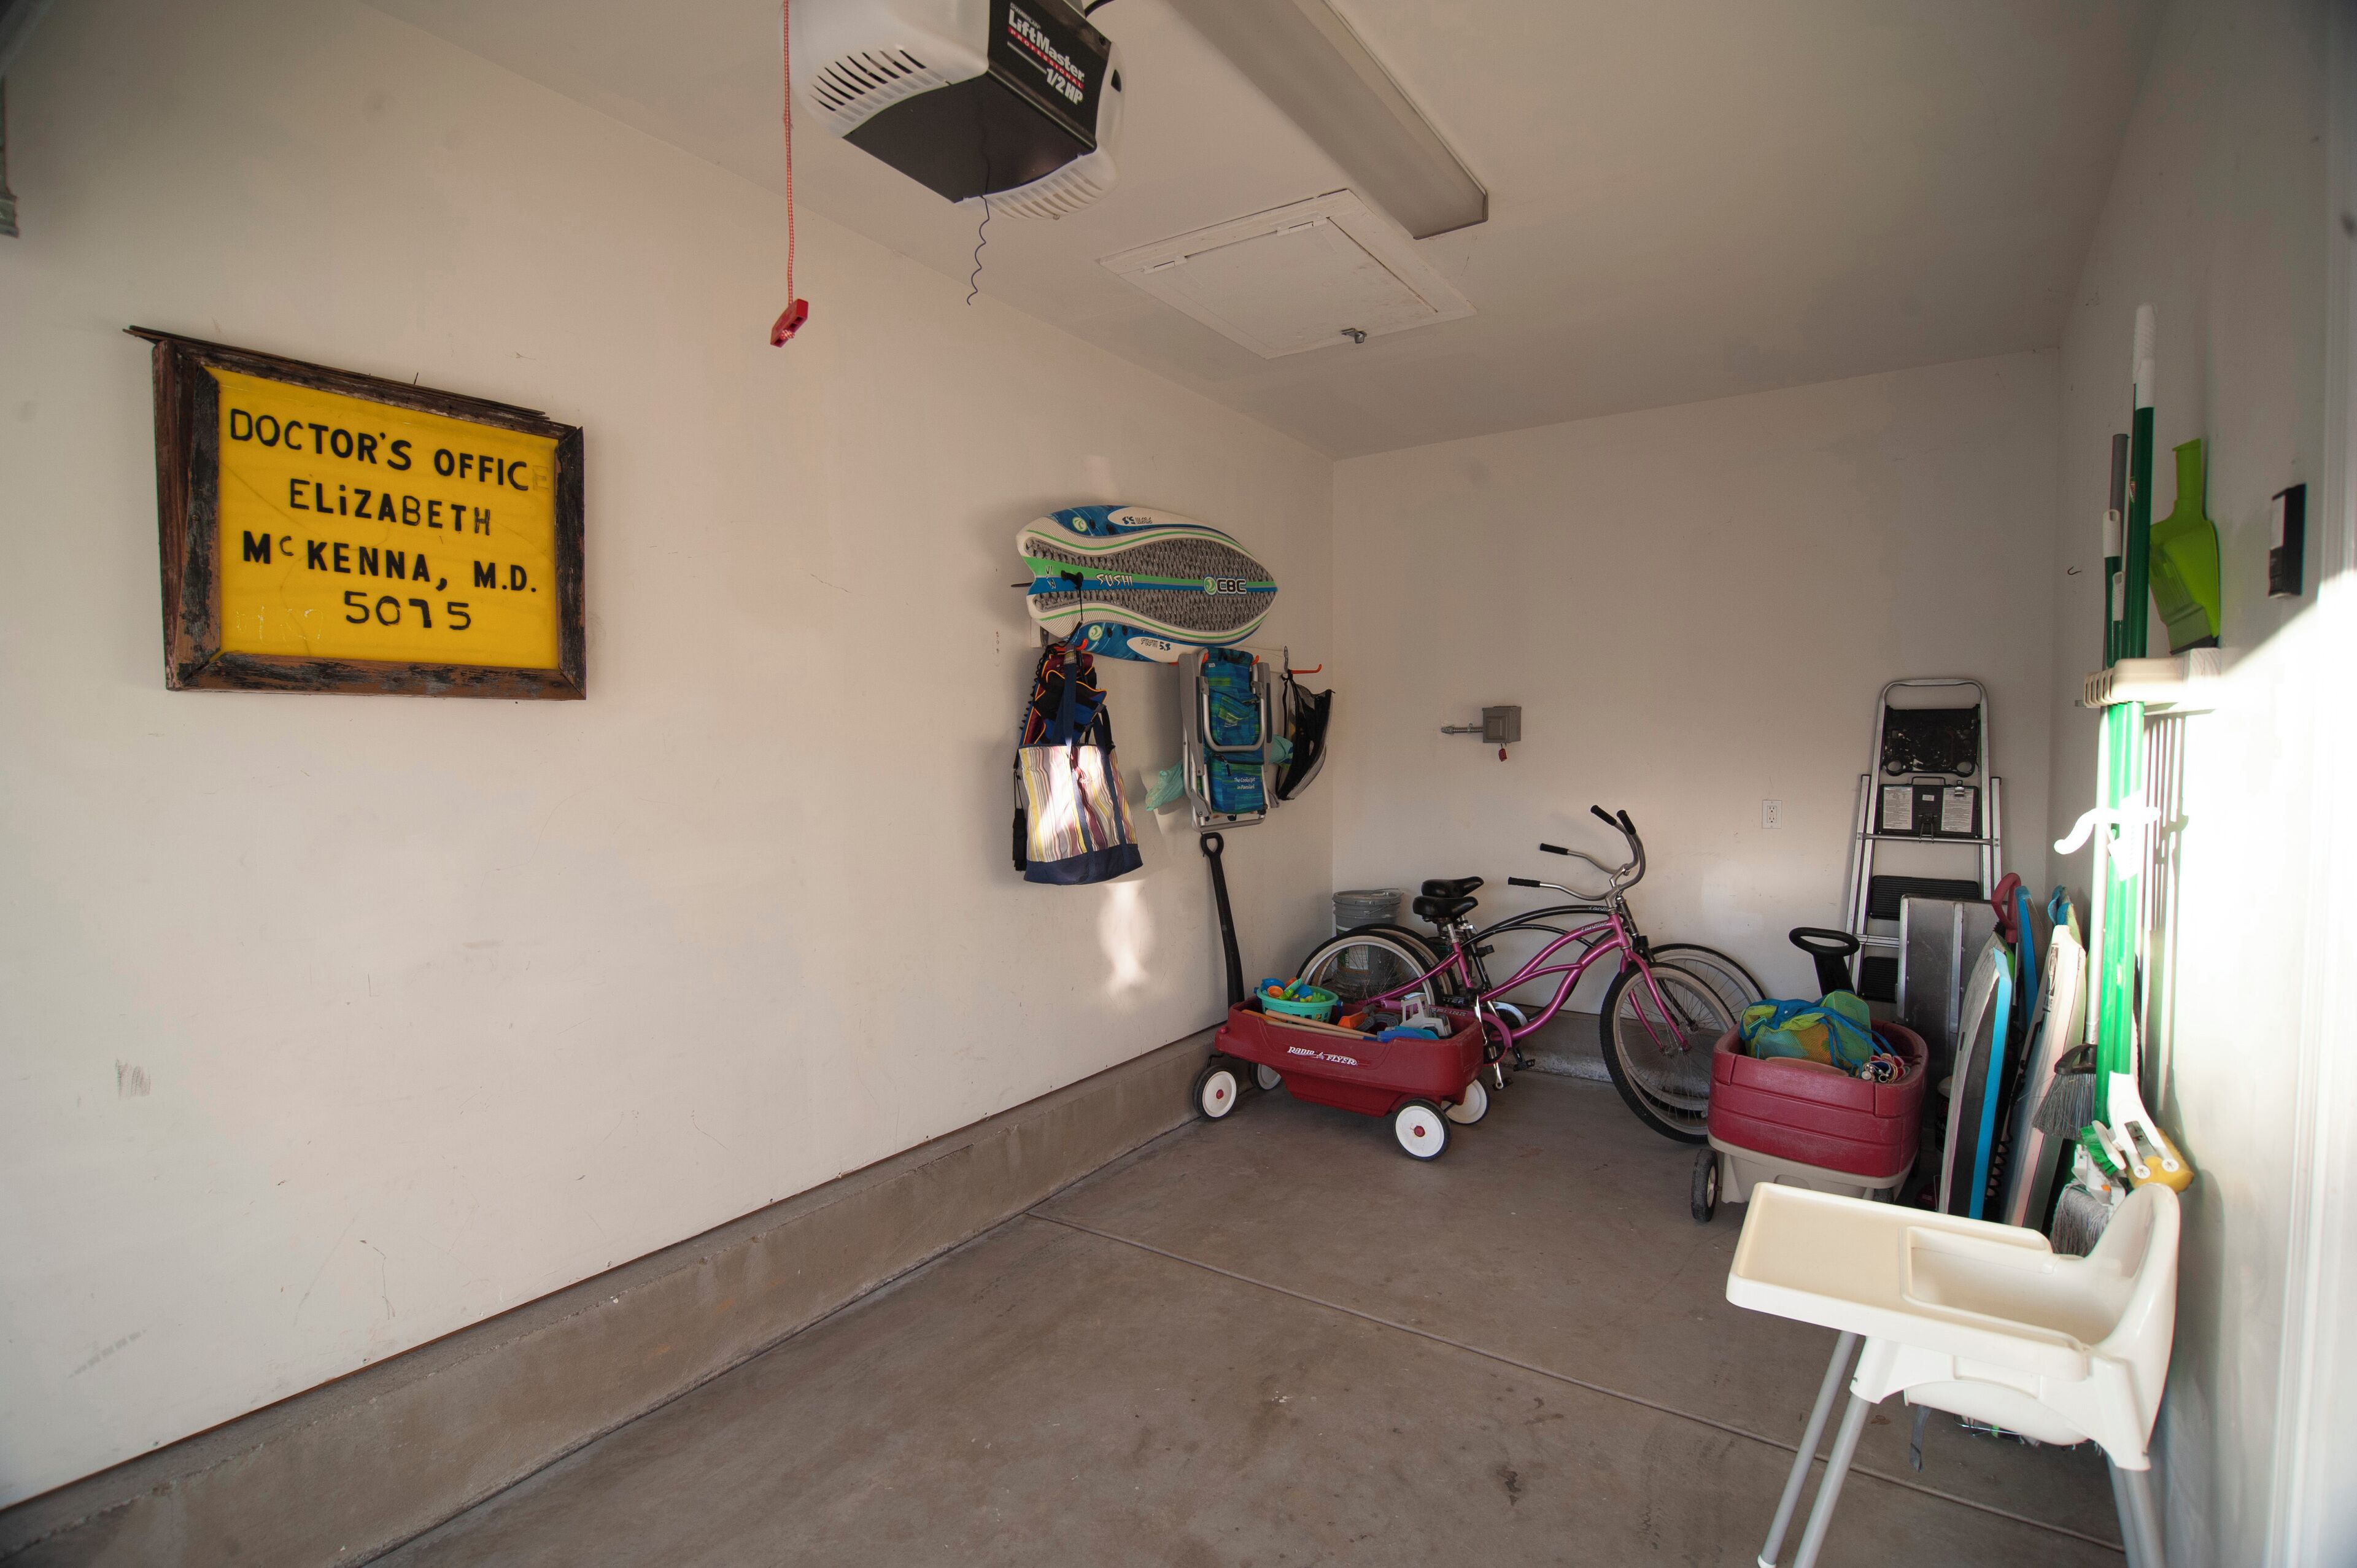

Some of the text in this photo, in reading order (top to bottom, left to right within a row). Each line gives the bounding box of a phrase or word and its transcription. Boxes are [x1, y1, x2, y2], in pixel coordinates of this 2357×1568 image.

[1008, 9, 1085, 82] LiftMaster
[1010, 28, 1083, 89] PROFESSIONAL
[230, 408, 412, 471] DOCTOR'S
[474, 560, 537, 593] M.D.
[1096, 573, 1134, 587] SUSHI
[1217, 578, 1247, 594] CBC
[344, 590, 472, 631] 5075
[1159, 641, 1171, 651] 5.8
[1287, 1046, 1357, 1066] RADIO FLYER
